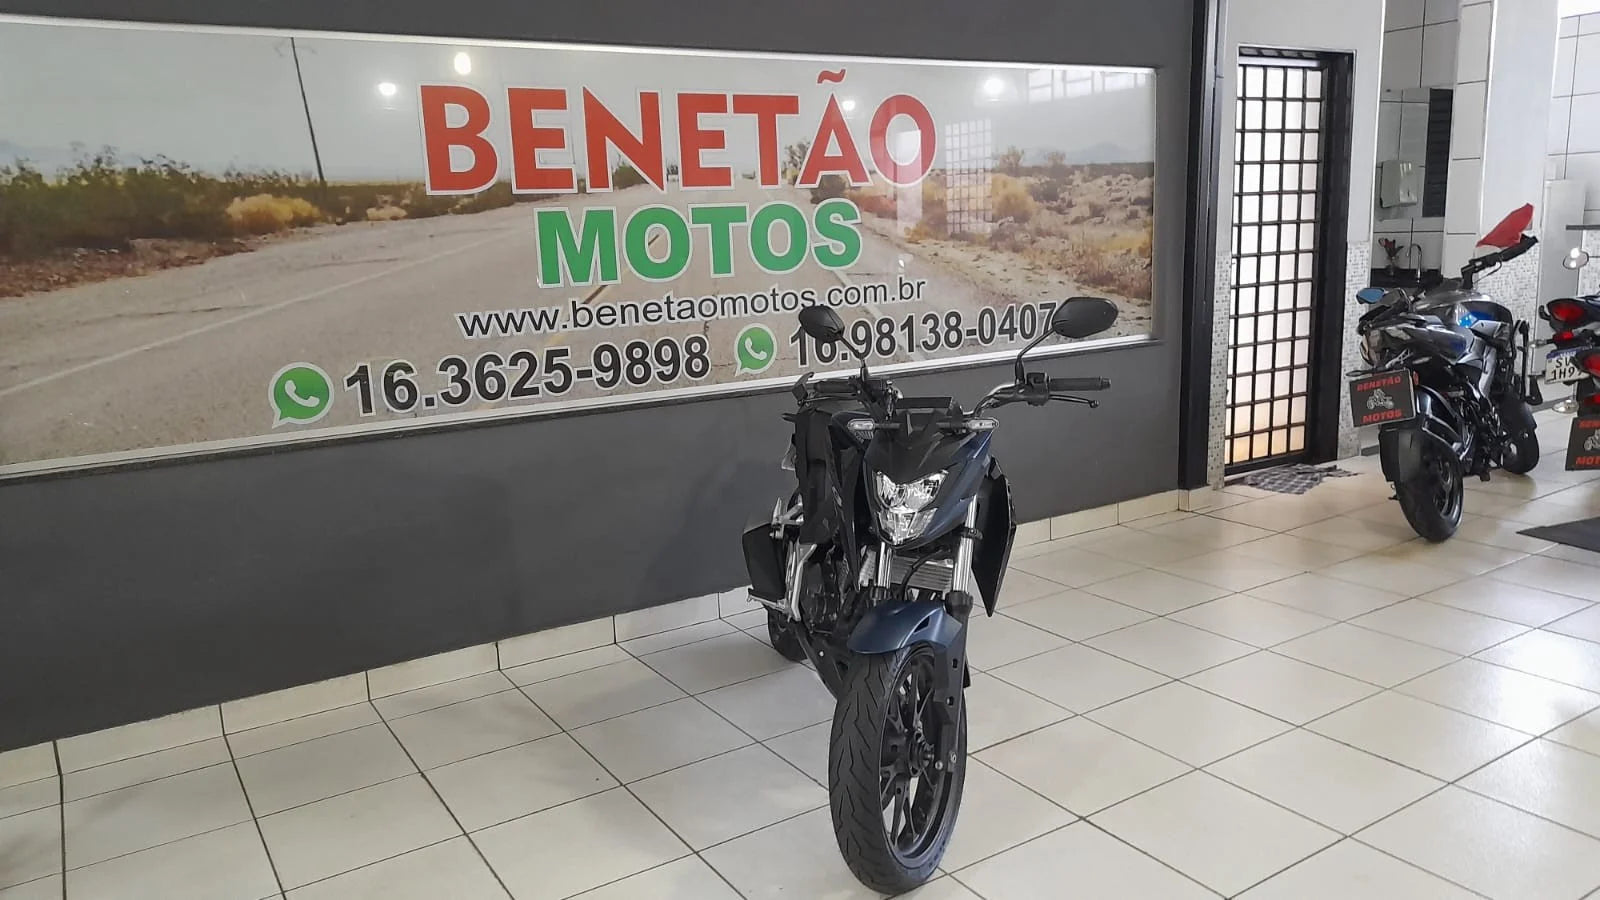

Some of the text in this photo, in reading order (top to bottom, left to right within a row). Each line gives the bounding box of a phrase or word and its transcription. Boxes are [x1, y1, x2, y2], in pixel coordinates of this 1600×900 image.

[419, 69, 936, 195] BENETÃO
[536, 200, 863, 287] MOTOS
[344, 336, 710, 415] 16.3625-9898
[1362, 409, 1402, 423] MOTOS
